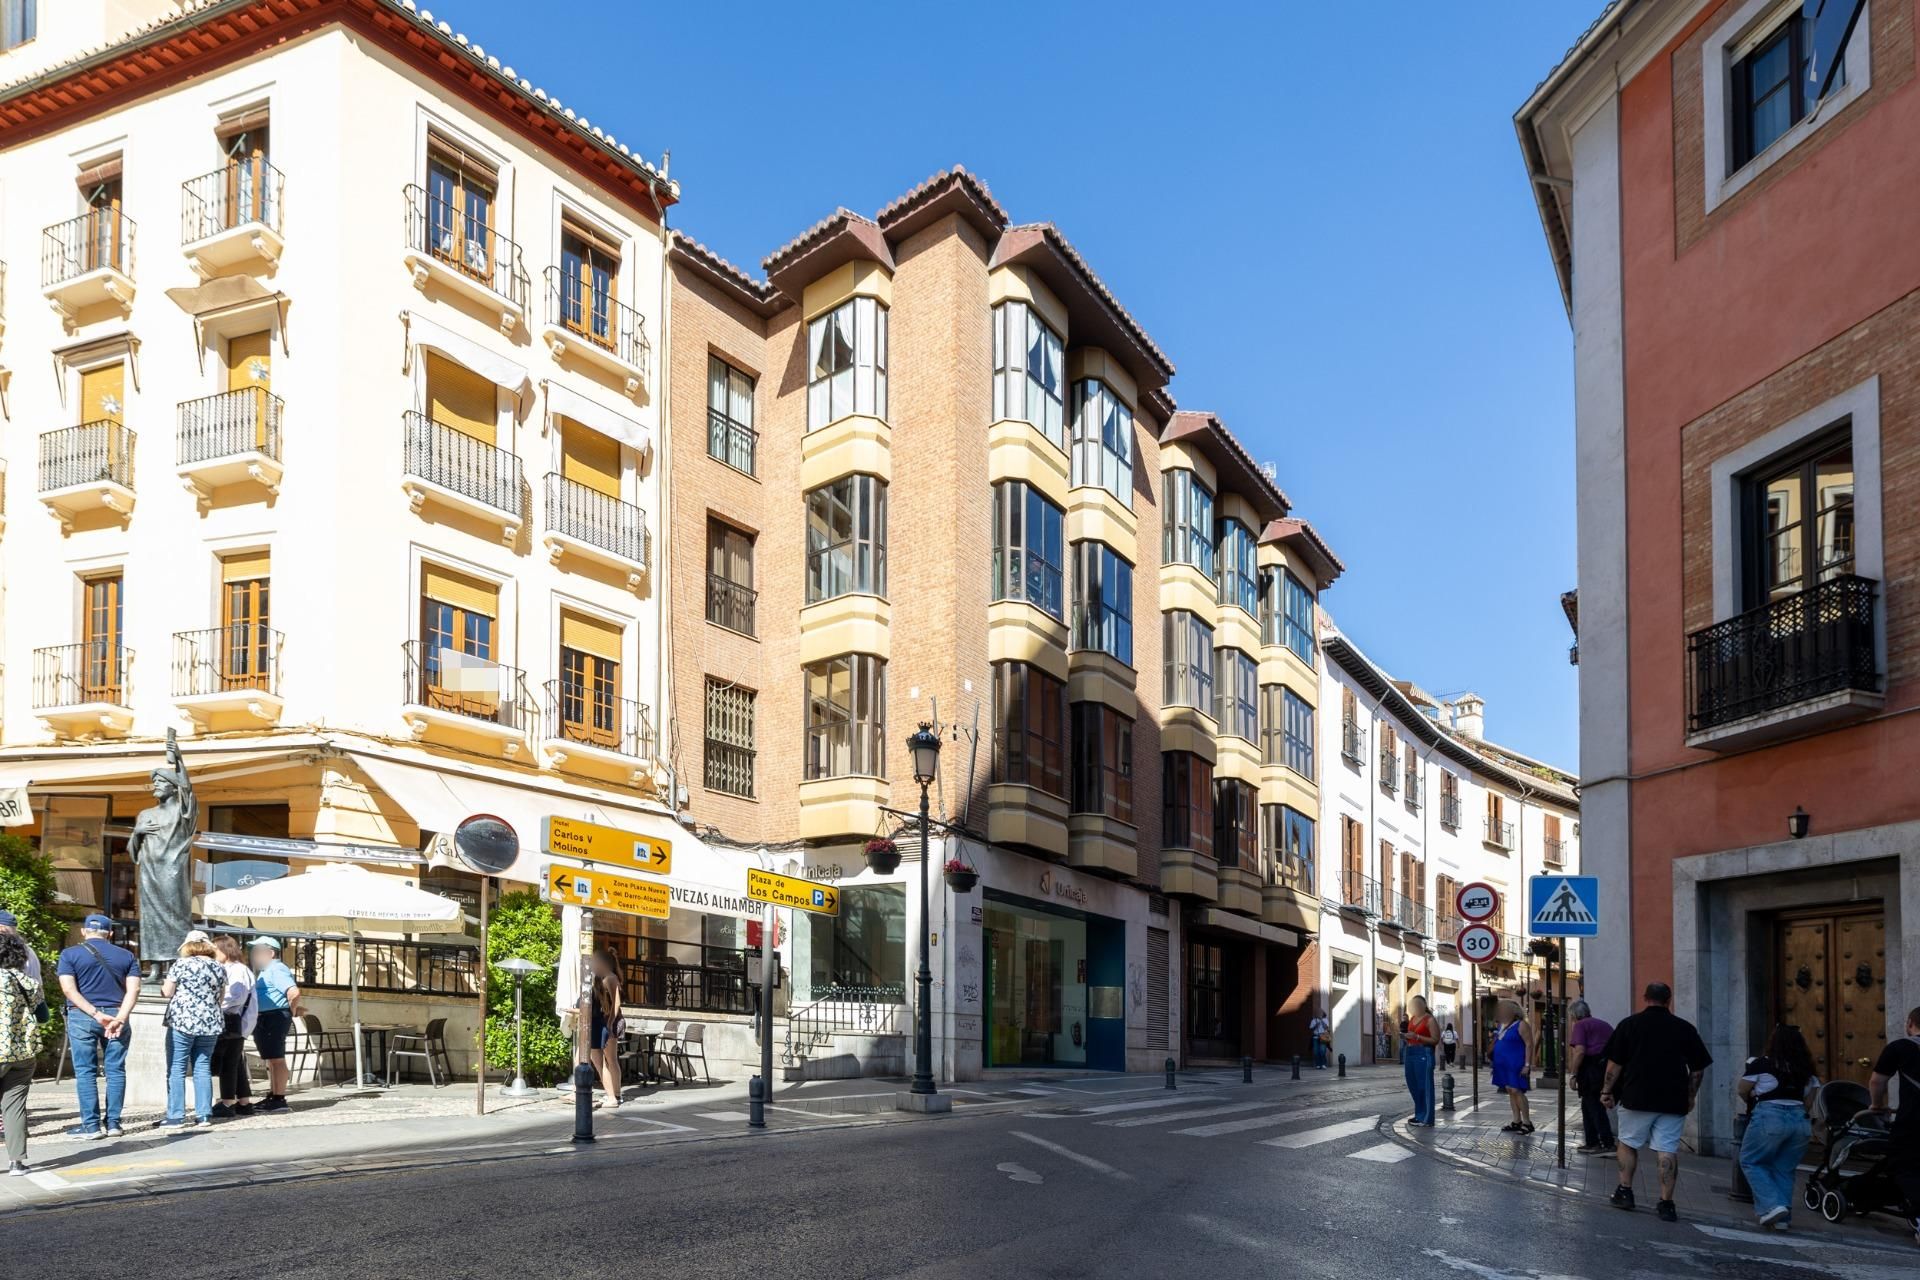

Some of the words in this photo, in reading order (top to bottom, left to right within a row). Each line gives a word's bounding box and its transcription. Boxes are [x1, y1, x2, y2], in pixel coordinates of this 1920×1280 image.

[554, 820, 570, 828] Hotel
[554, 828, 584, 842] Carlos
[587, 835, 593, 844] V
[553, 841, 588, 855] Molinos
[613, 880, 628, 888] Zona
[630, 883, 647, 891] Plaza
[648, 886, 666, 895] Nueva
[750, 873, 772, 886] Plaza
[775, 879, 785, 888] de
[750, 885, 767, 898] Los
[772, 889, 810, 907] Campos
[1056, 882, 1088, 904] Unicaja
[1466, 937, 1490, 951] 30
